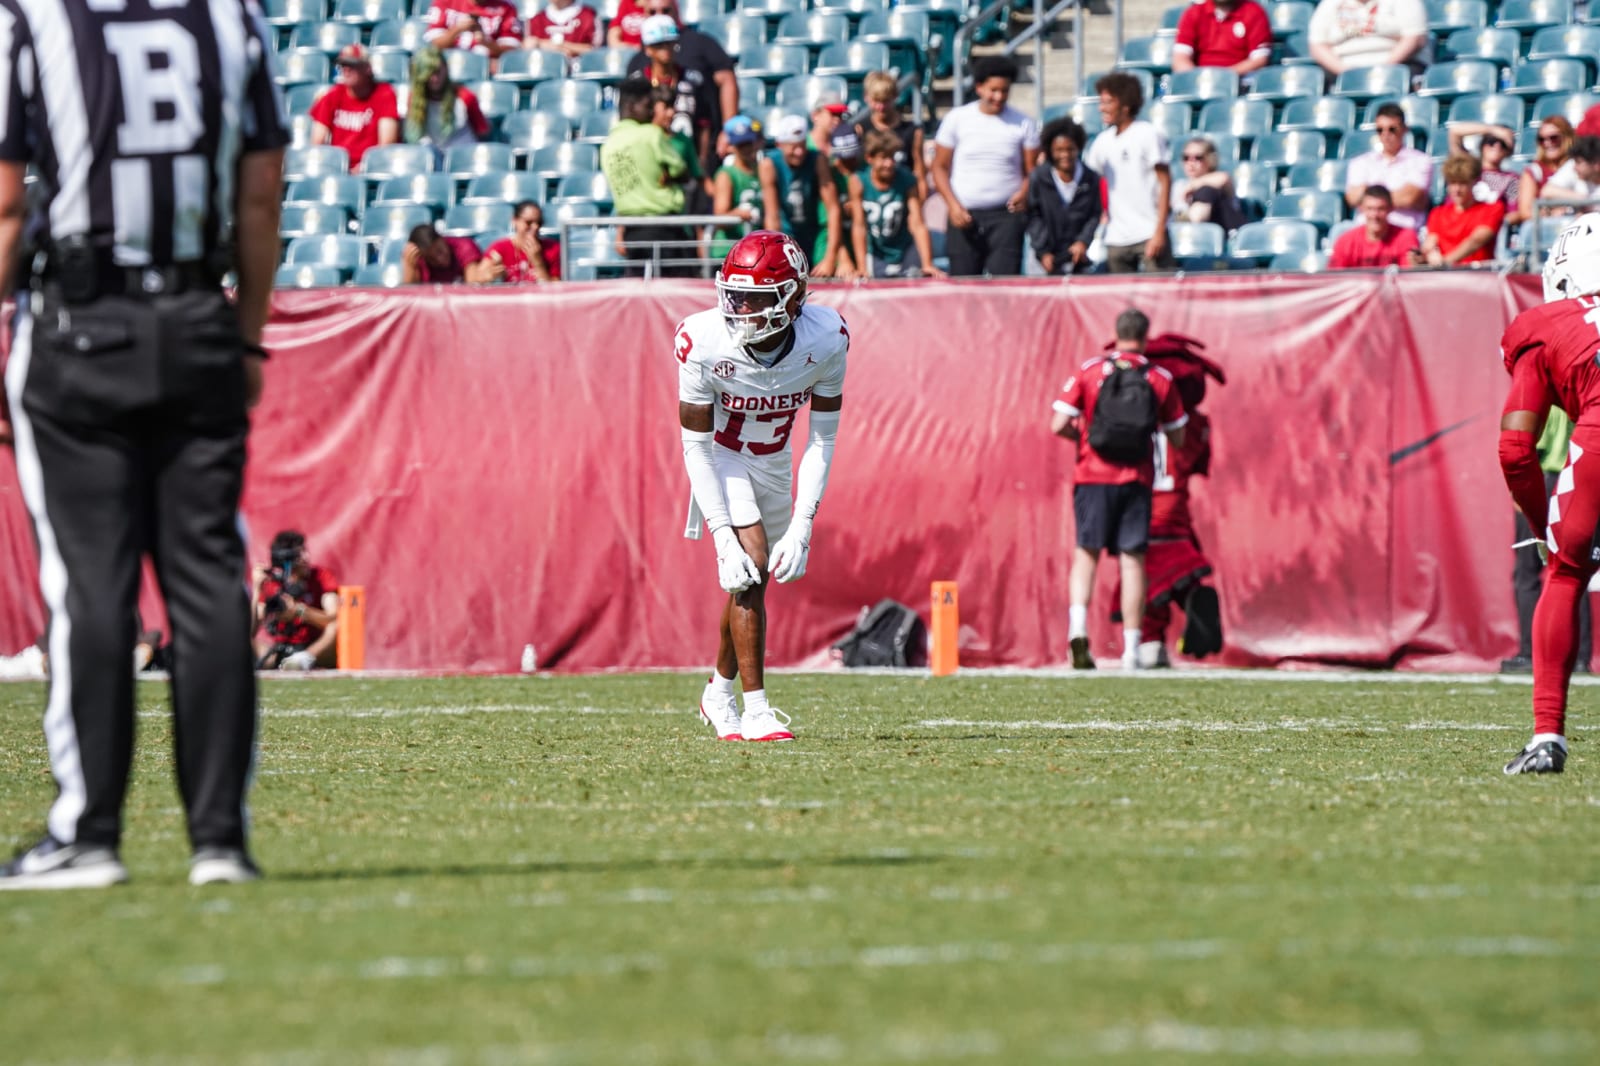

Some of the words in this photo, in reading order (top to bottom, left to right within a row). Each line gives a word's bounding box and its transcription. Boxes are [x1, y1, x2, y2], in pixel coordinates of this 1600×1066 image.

[103, 19, 205, 155] B
[715, 361, 735, 378] SEC
[721, 386, 812, 411] SOONERS
[713, 407, 798, 456] 13
